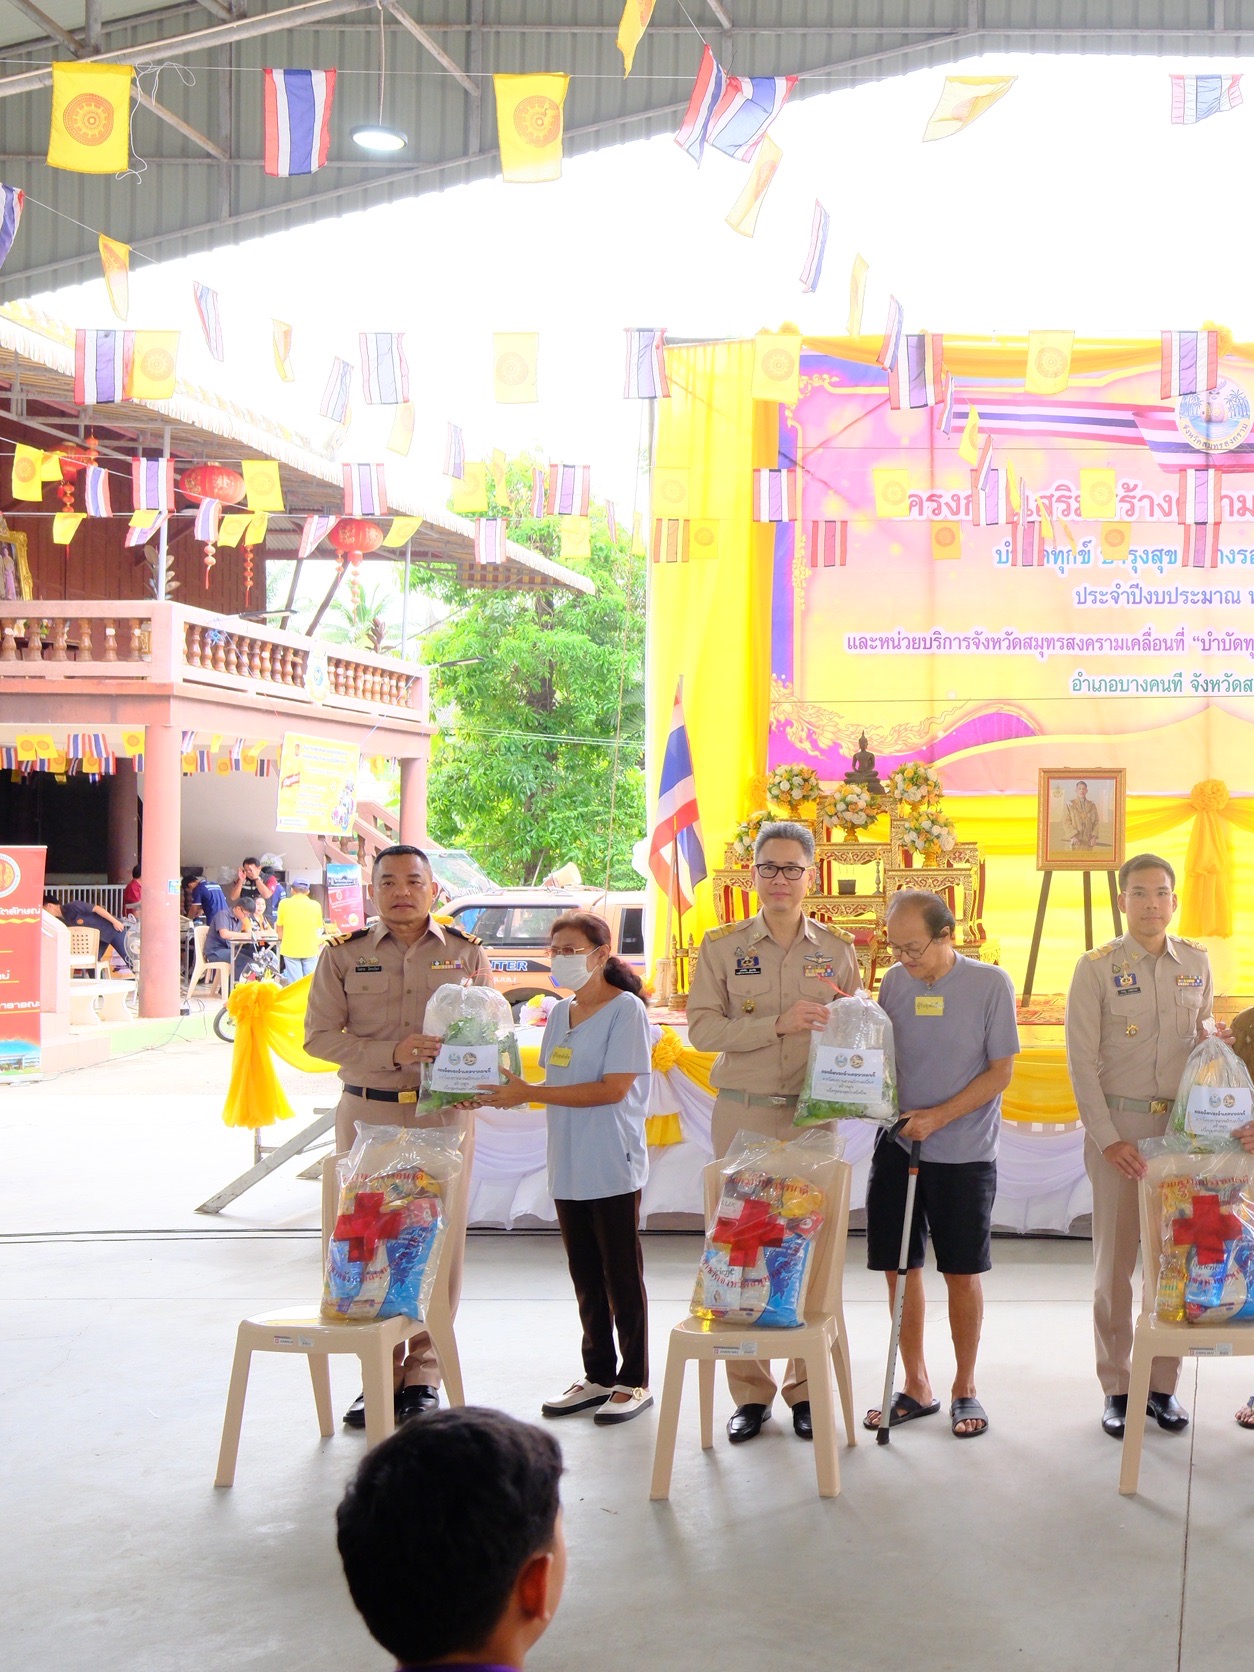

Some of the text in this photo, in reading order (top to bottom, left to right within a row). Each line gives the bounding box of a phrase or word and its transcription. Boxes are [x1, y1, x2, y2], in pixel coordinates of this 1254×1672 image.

[1075, 583, 1241, 605] ประจำปีงบประมาณ
[846, 627, 1185, 659] และหน่วยบริการจังหวัดสมุทรสงครามเคลื่อนที่
